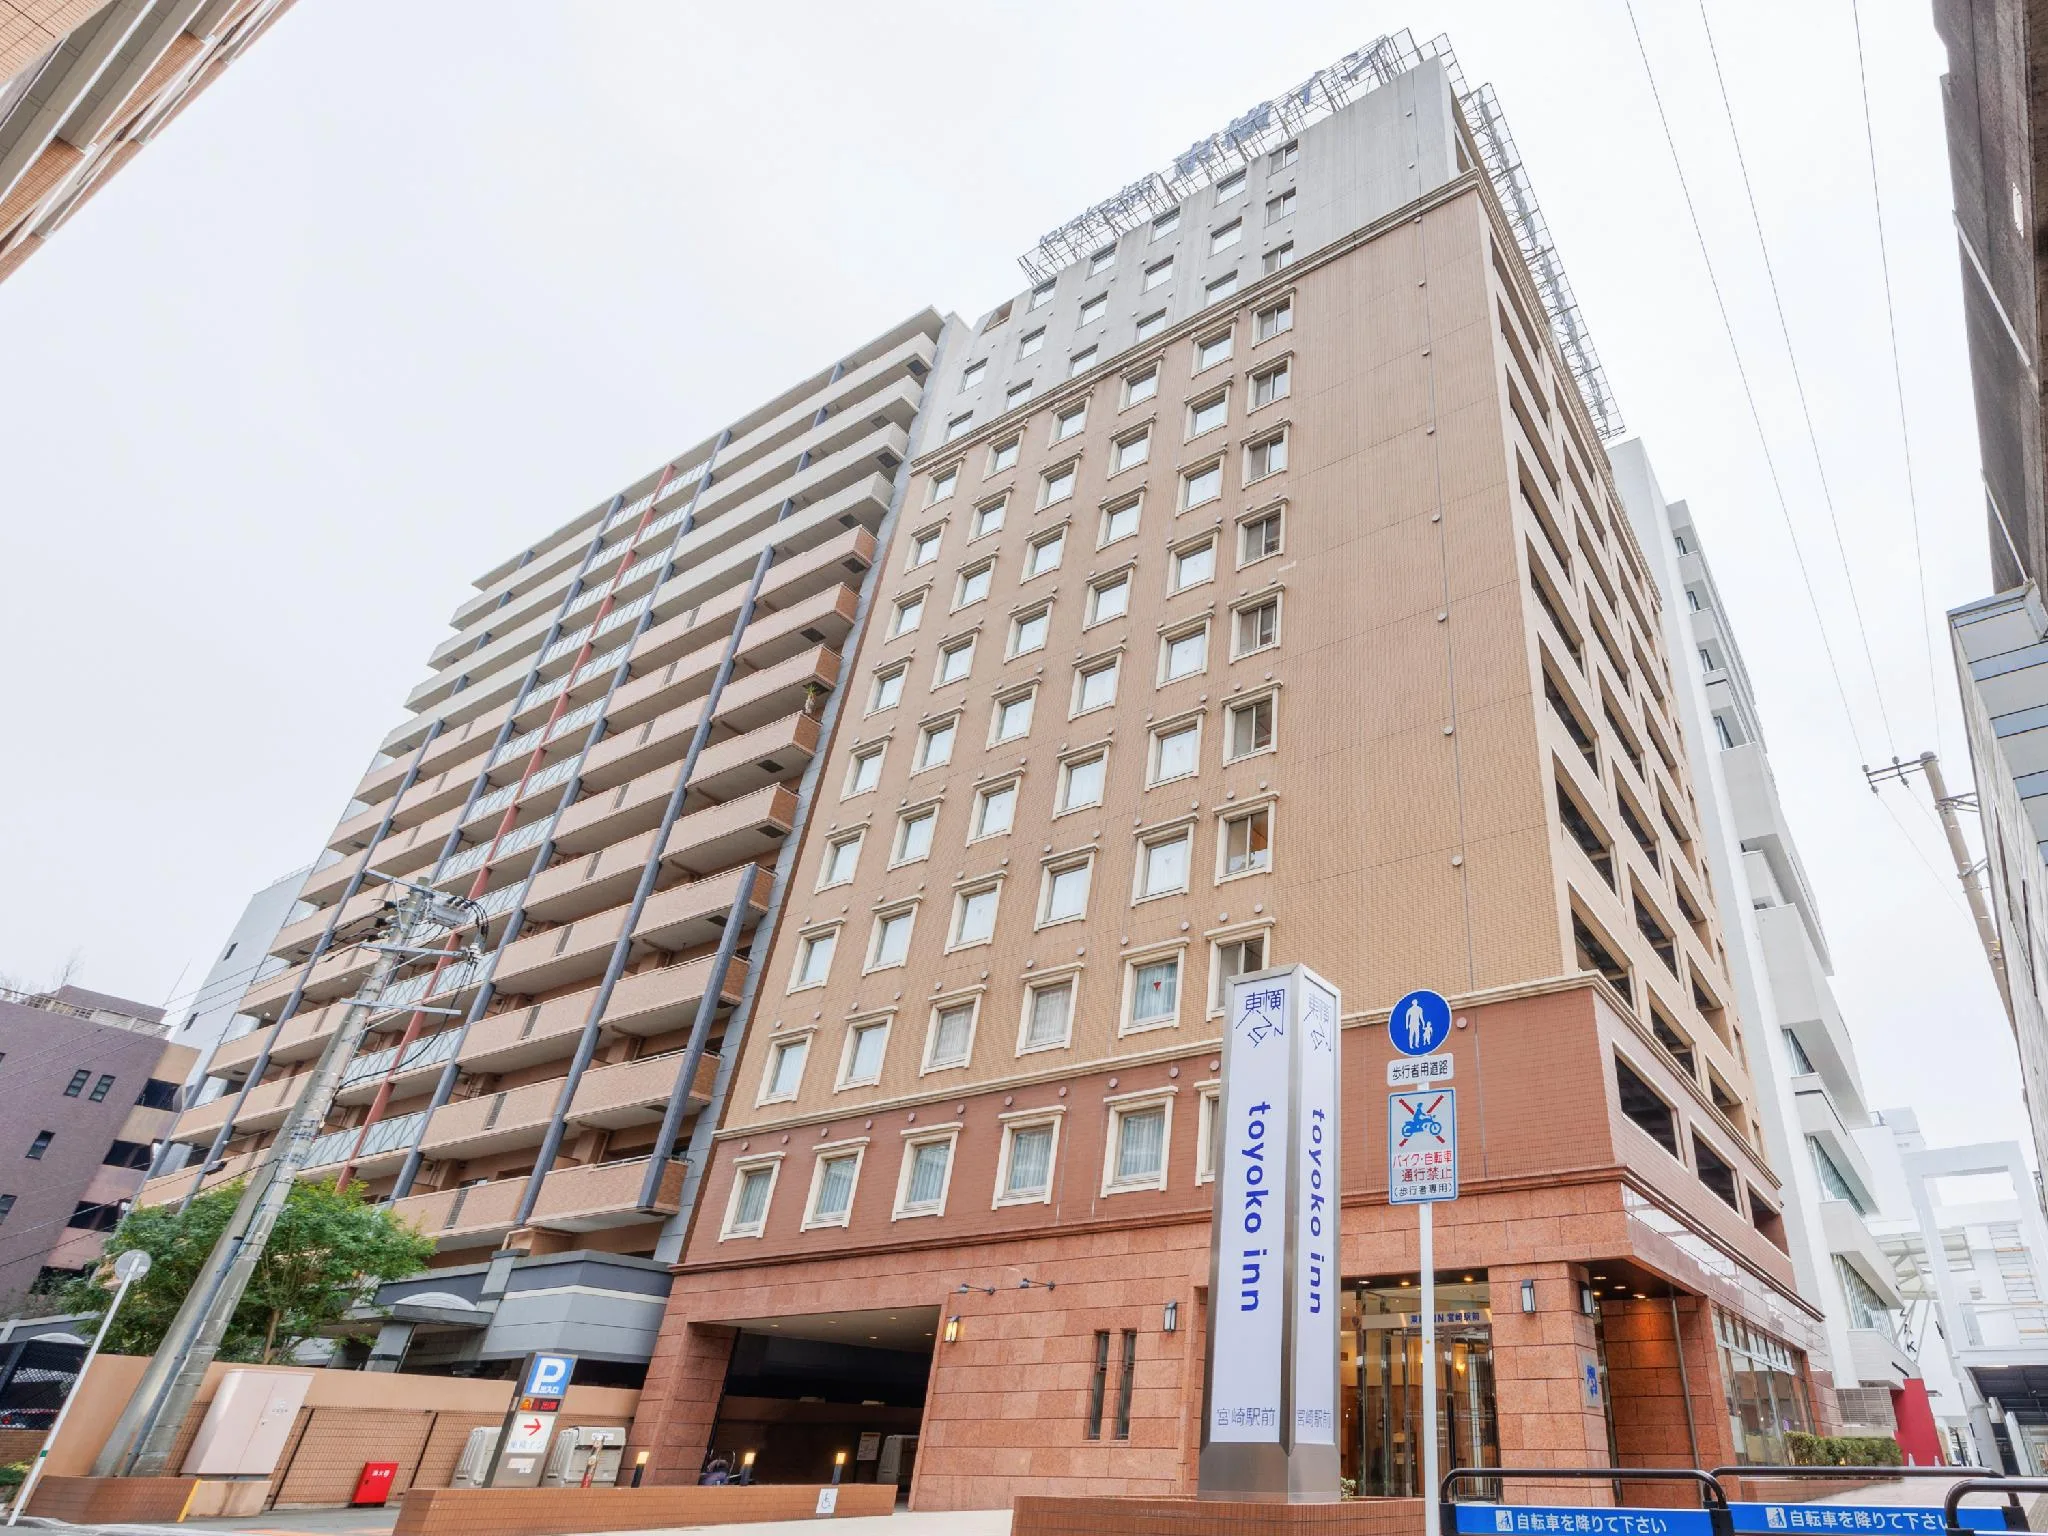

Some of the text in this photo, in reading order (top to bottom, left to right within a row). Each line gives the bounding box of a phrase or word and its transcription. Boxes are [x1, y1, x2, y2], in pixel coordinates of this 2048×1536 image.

[1393, 1060, 1448, 1080] 歩行者用道路
[1401, 1167, 1452, 1182] 通行禁止
[1241, 1101, 1271, 1311] toyoko inn
[1308, 1108, 1325, 1314] toyoko inn
[531, 1357, 567, 1393] P
[1217, 1407, 1276, 1426] 宮崎駅前
[1517, 1512, 1667, 1534] 自転車を降りて下さい
